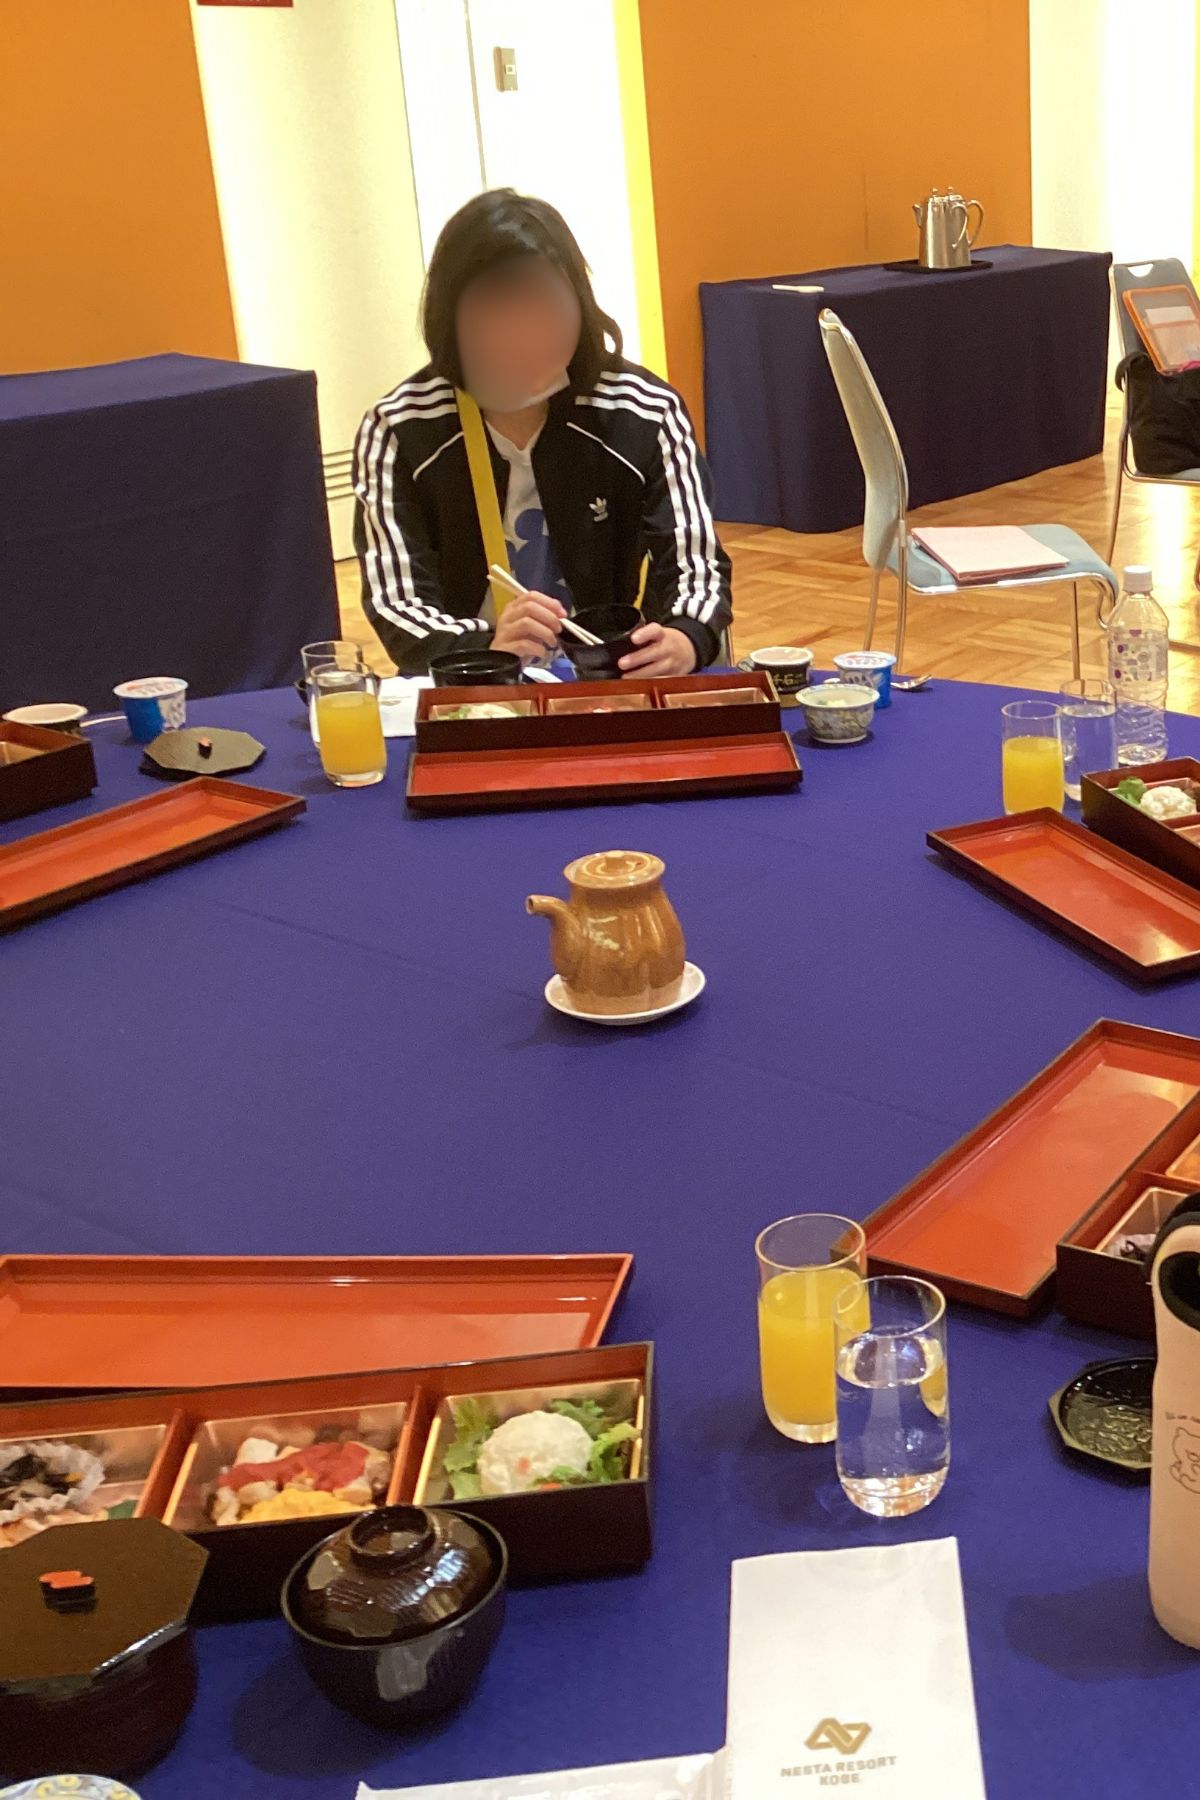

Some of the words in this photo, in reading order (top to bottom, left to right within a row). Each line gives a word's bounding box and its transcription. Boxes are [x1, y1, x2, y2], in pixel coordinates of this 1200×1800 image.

[781, 1763, 832, 1777] NESTA
[836, 1756, 897, 1772] RESORT
[819, 1773, 860, 1786] KOBE
